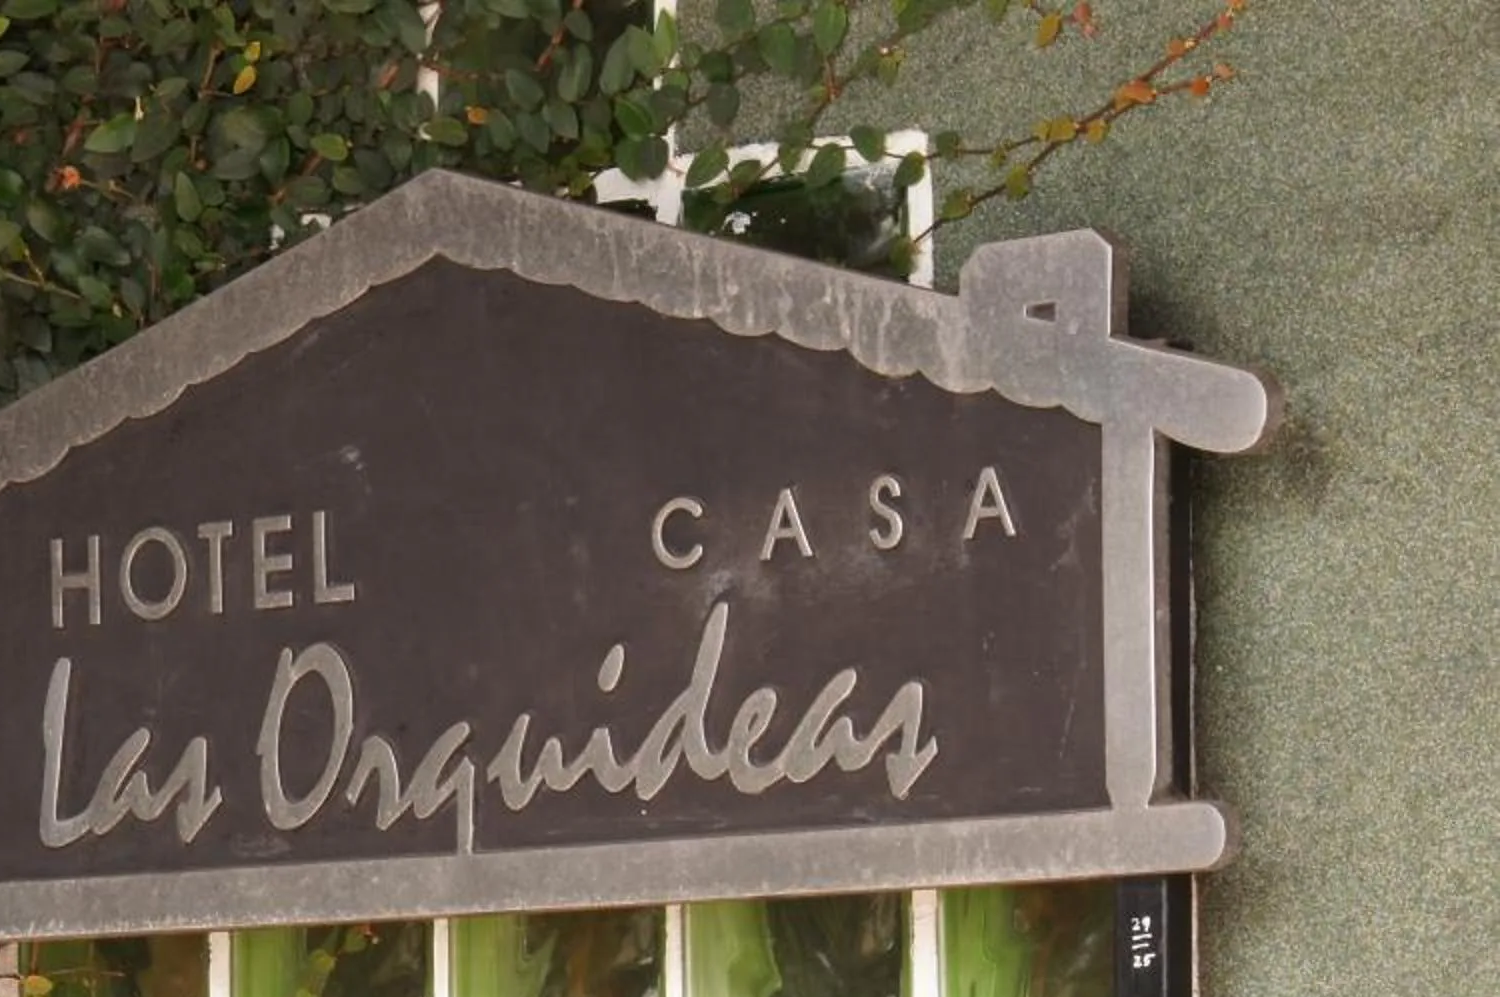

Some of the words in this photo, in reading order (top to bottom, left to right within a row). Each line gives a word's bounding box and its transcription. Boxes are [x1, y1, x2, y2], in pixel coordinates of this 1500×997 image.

[49, 510, 356, 629] HOTEL
[650, 465, 1017, 571] CASA
[39, 656, 223, 848] Las
